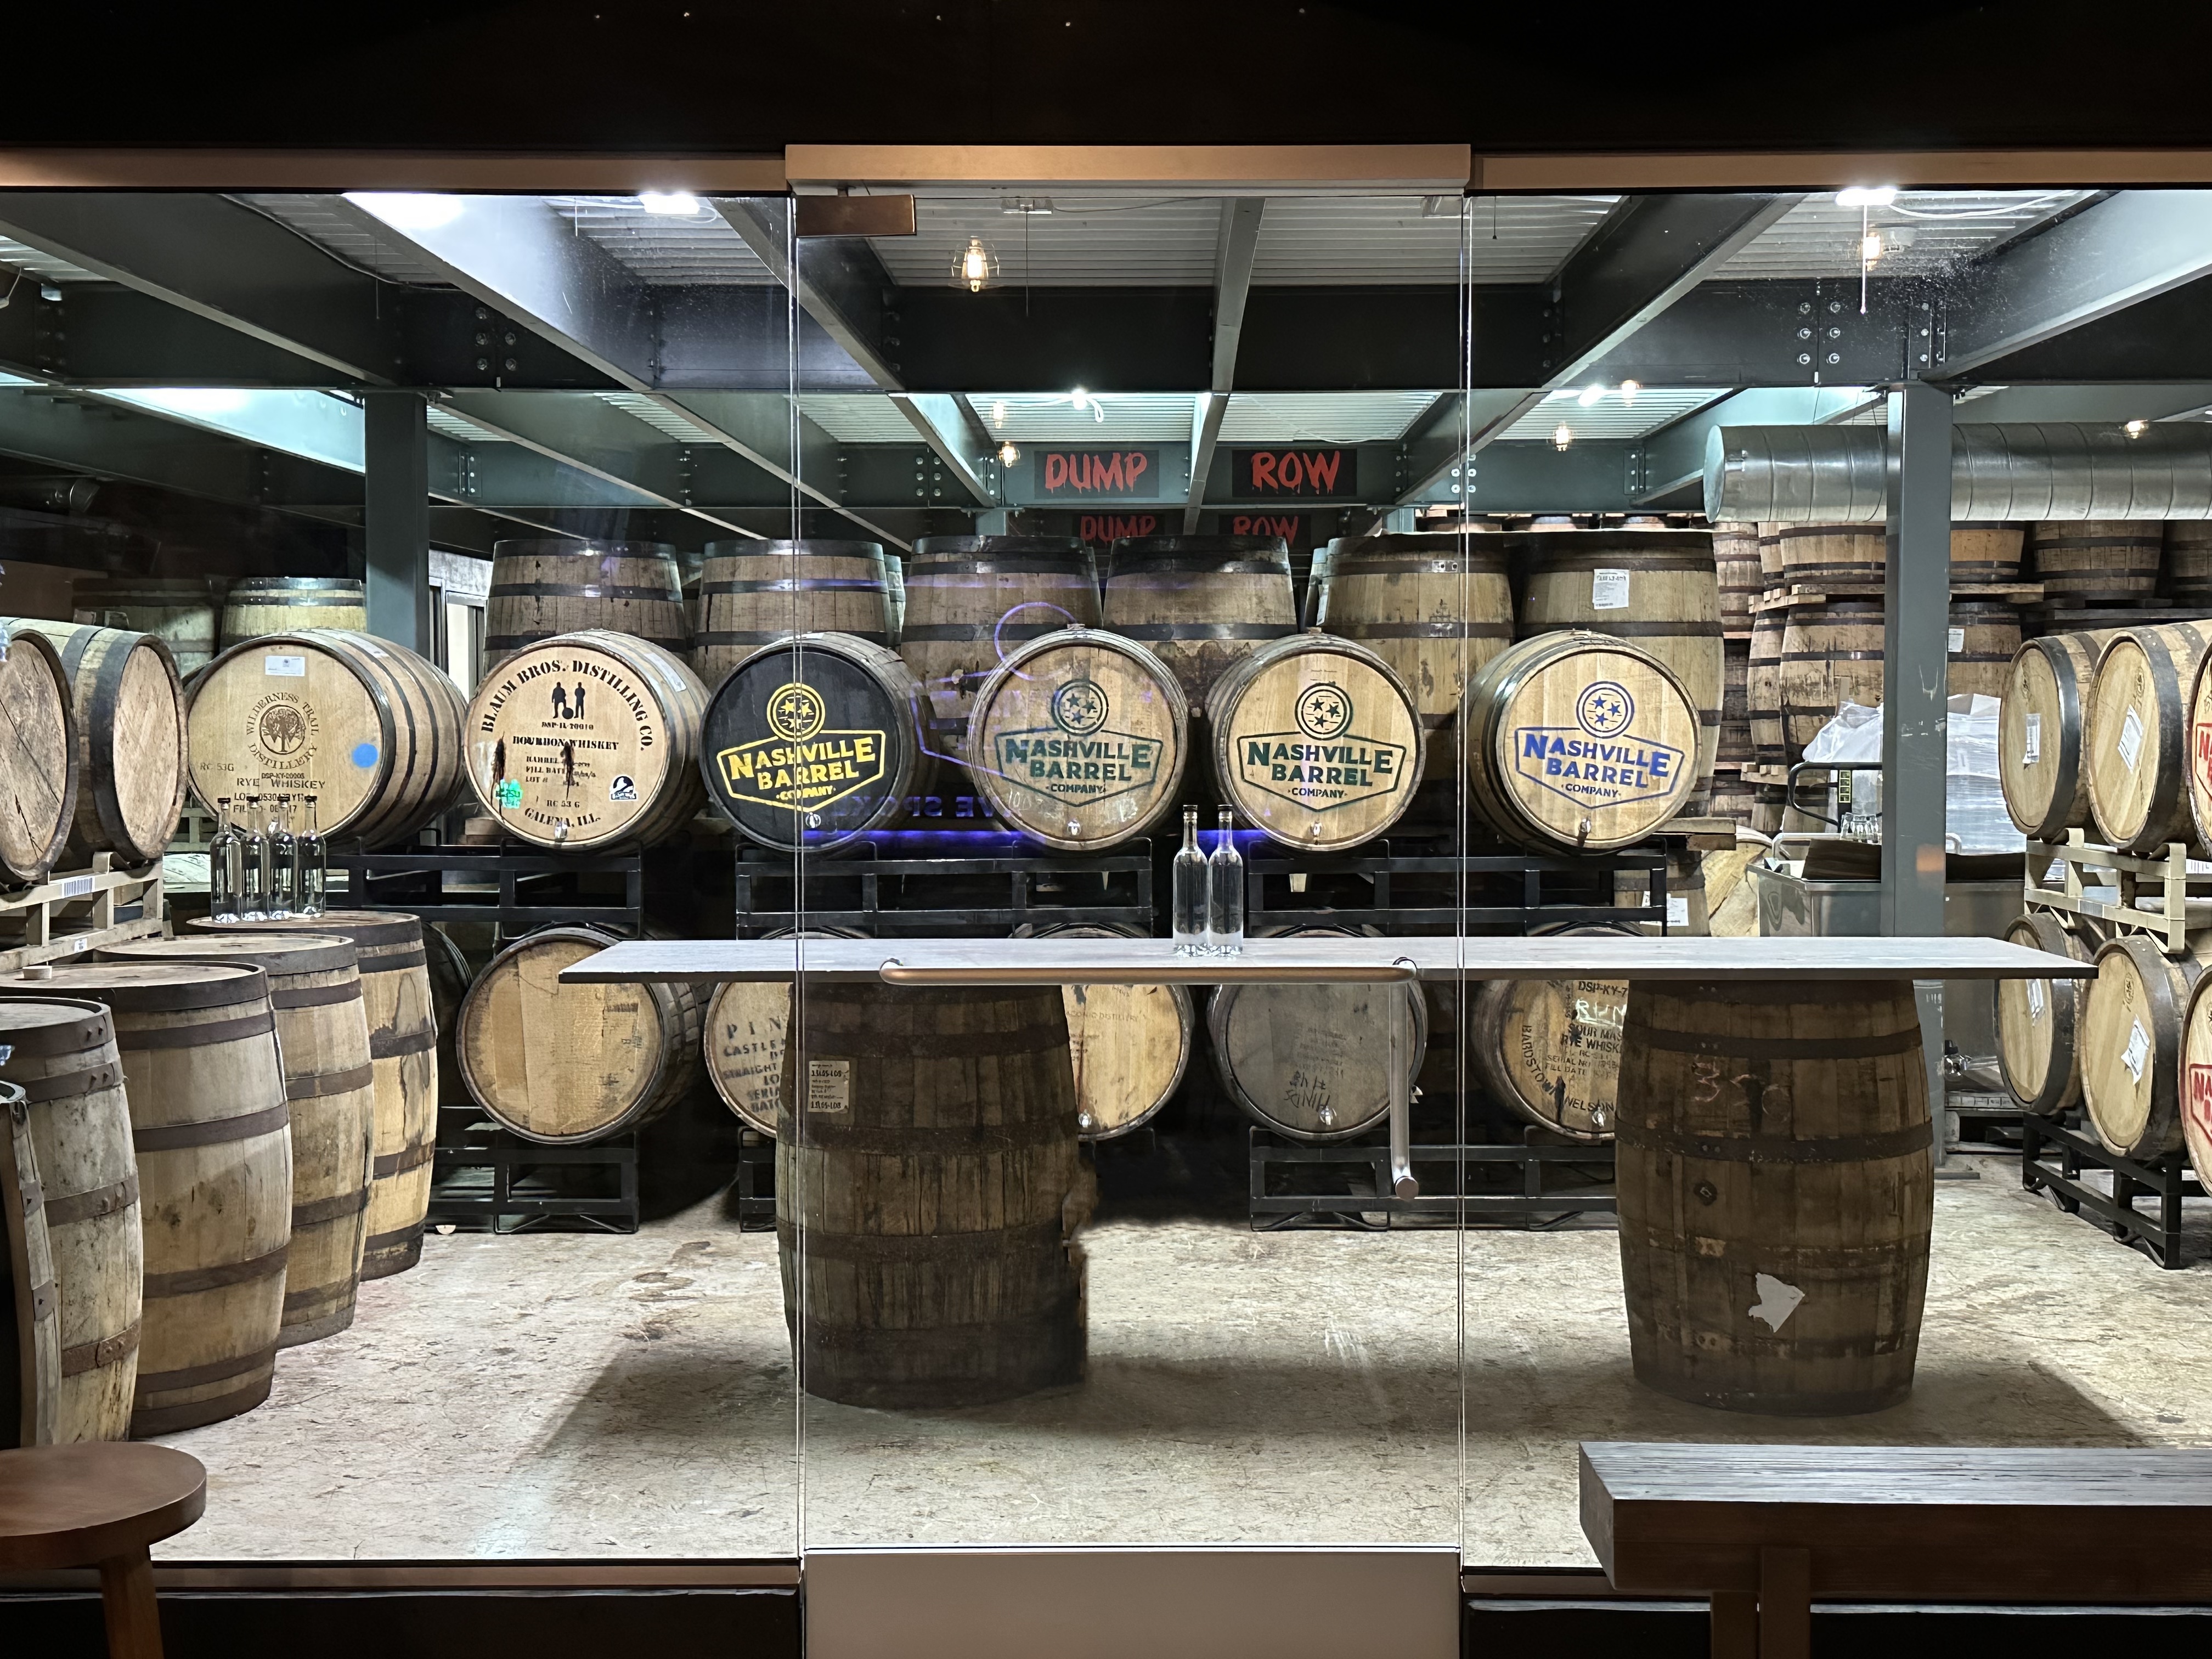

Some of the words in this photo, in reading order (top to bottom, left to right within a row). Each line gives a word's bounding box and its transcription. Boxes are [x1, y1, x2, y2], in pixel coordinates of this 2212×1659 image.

[1046, 452, 1147, 494] DUMP
[1252, 450, 1340, 494] ROW
[1080, 516, 1156, 542] DUMP
[1233, 516, 1299, 544] ROW
[246, 692, 299, 735] WILDERNESS
[302, 702, 319, 736] TRAIL
[481, 680, 517, 732] BLAUM
[516, 660, 566, 684] BROS.
[573, 661, 648, 721] DISTILLING
[639, 725, 653, 751] CO.
[513, 736, 566, 747] BOURBON
[569, 739, 619, 750] WHISKEY
[1005, 738, 1153, 769] NASHVILLE
[1523, 733, 1671, 777] NASHVILLE
[248, 743, 318, 769] DISTILLERY
[729, 737, 876, 780] NASHVILLE
[1247, 742, 1393, 774] NASHVILLE
[758, 760, 859, 790] BARREL
[1030, 759, 1132, 781] BARREL
[1271, 764, 1373, 786] BARREL
[1545, 758, 1649, 788] BARREL
[237, 778, 259, 786] RYE
[271, 778, 325, 788] WHISKEY
[1051, 783, 1104, 794] COMPANY
[1291, 787, 1345, 798] COMPANY
[1565, 783, 1618, 798] COMPANY
[724, 1040, 776, 1057] CASTLE
[1587, 1039, 1621, 1053] WHISK
[723, 1063, 777, 1079] STRAIGHT
[1545, 1063, 1561, 1071] FILL
